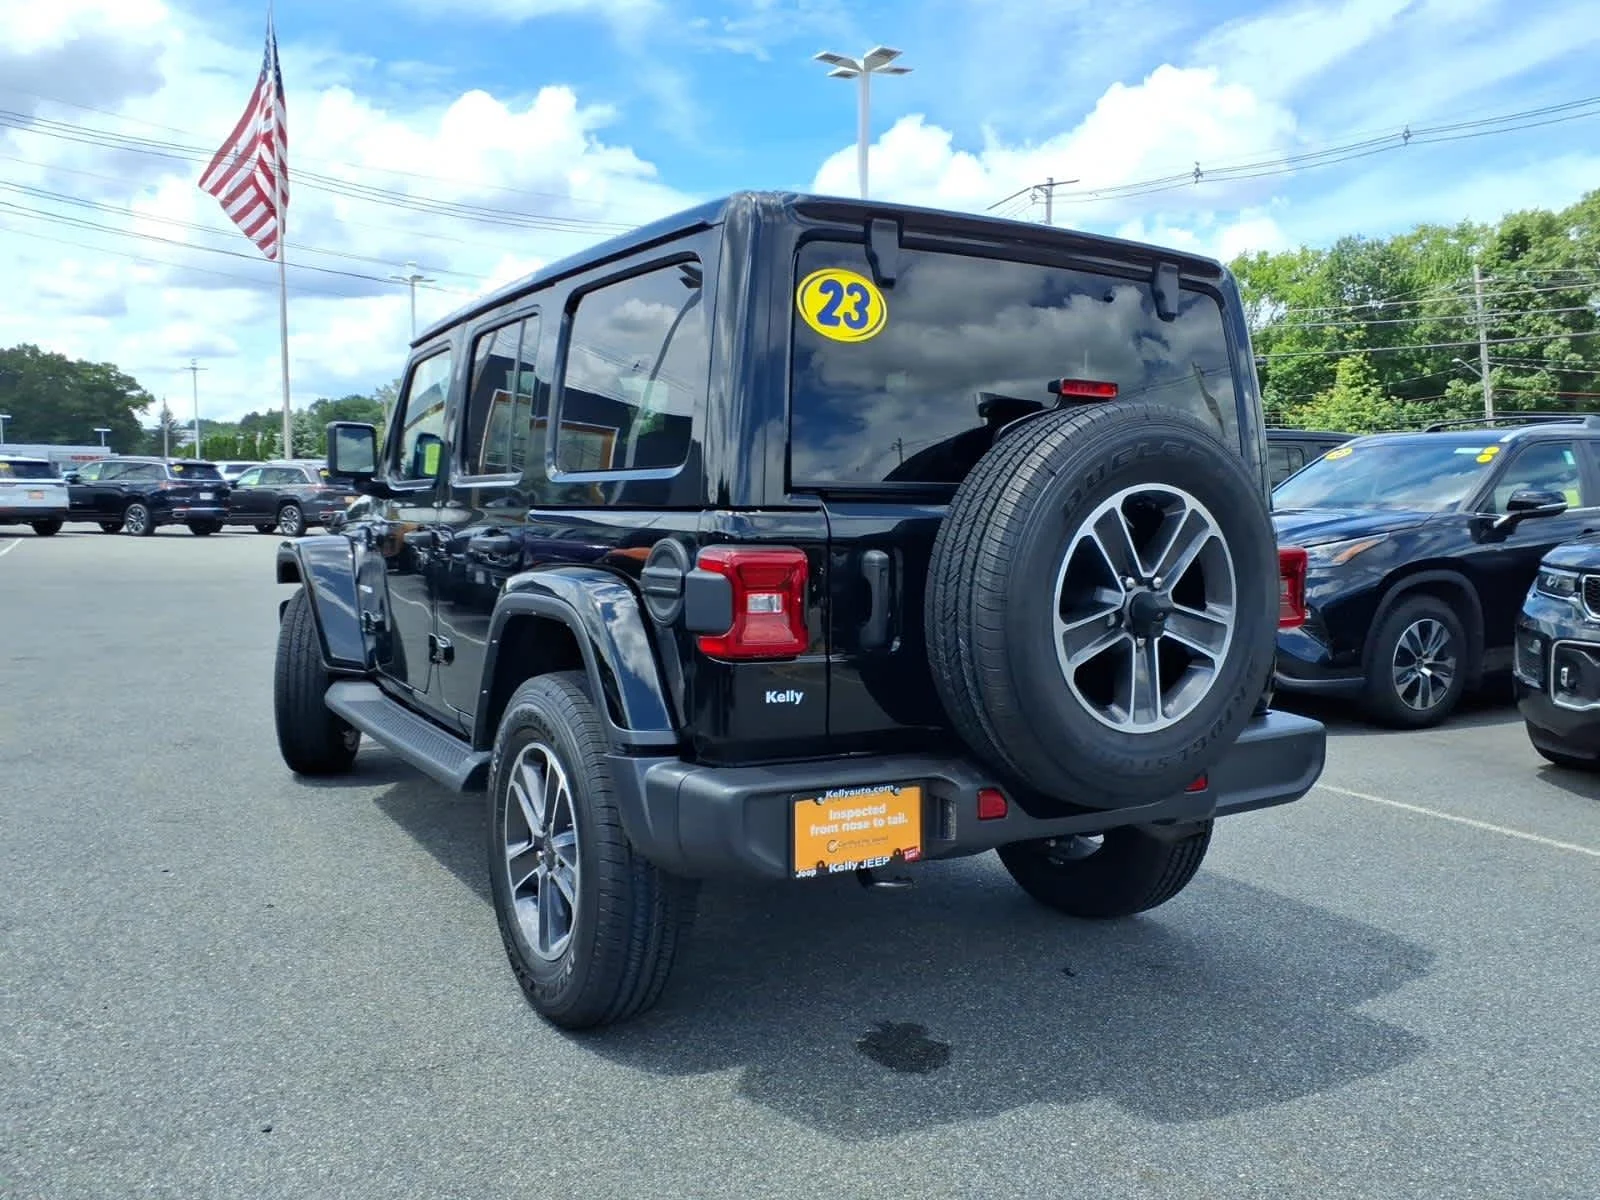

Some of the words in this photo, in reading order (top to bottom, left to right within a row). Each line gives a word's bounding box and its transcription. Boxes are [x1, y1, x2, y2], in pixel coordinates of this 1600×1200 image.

[816, 279, 870, 329] 23
[765, 690, 804, 705] Kelly
[825, 784, 895, 799] Kellyauto.com
[829, 803, 887, 821] Inspected
[810, 823, 838, 837] from
[842, 820, 870, 832] nose
[873, 817, 885, 828] to
[887, 812, 909, 826] tail.
[828, 859, 859, 873] Kelly
[860, 856, 890, 869] JEEP
